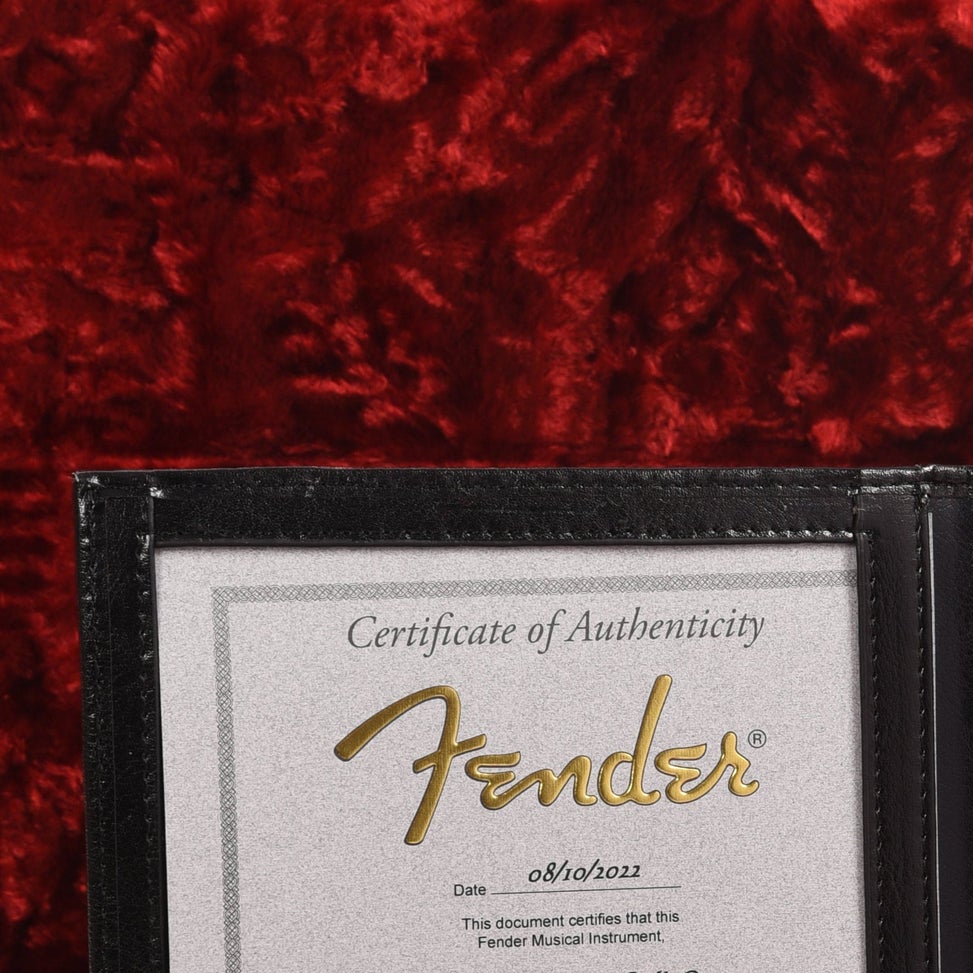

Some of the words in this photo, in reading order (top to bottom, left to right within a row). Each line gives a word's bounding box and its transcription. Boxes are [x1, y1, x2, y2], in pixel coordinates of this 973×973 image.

[348, 612, 516, 657] Certificate
[528, 607, 566, 654] of
[567, 607, 764, 648] Authenticity
[454, 884, 486, 896] Date
[528, 859, 640, 884] 08/10/2022
[462, 918, 491, 930] This
[496, 915, 564, 929] document
[569, 913, 621, 926] certifies
[626, 912, 651, 924] that
[656, 911, 679, 923] this
[478, 936, 527, 948] Fender
[532, 933, 584, 946] Musical
[589, 931, 664, 944] Instrument,
